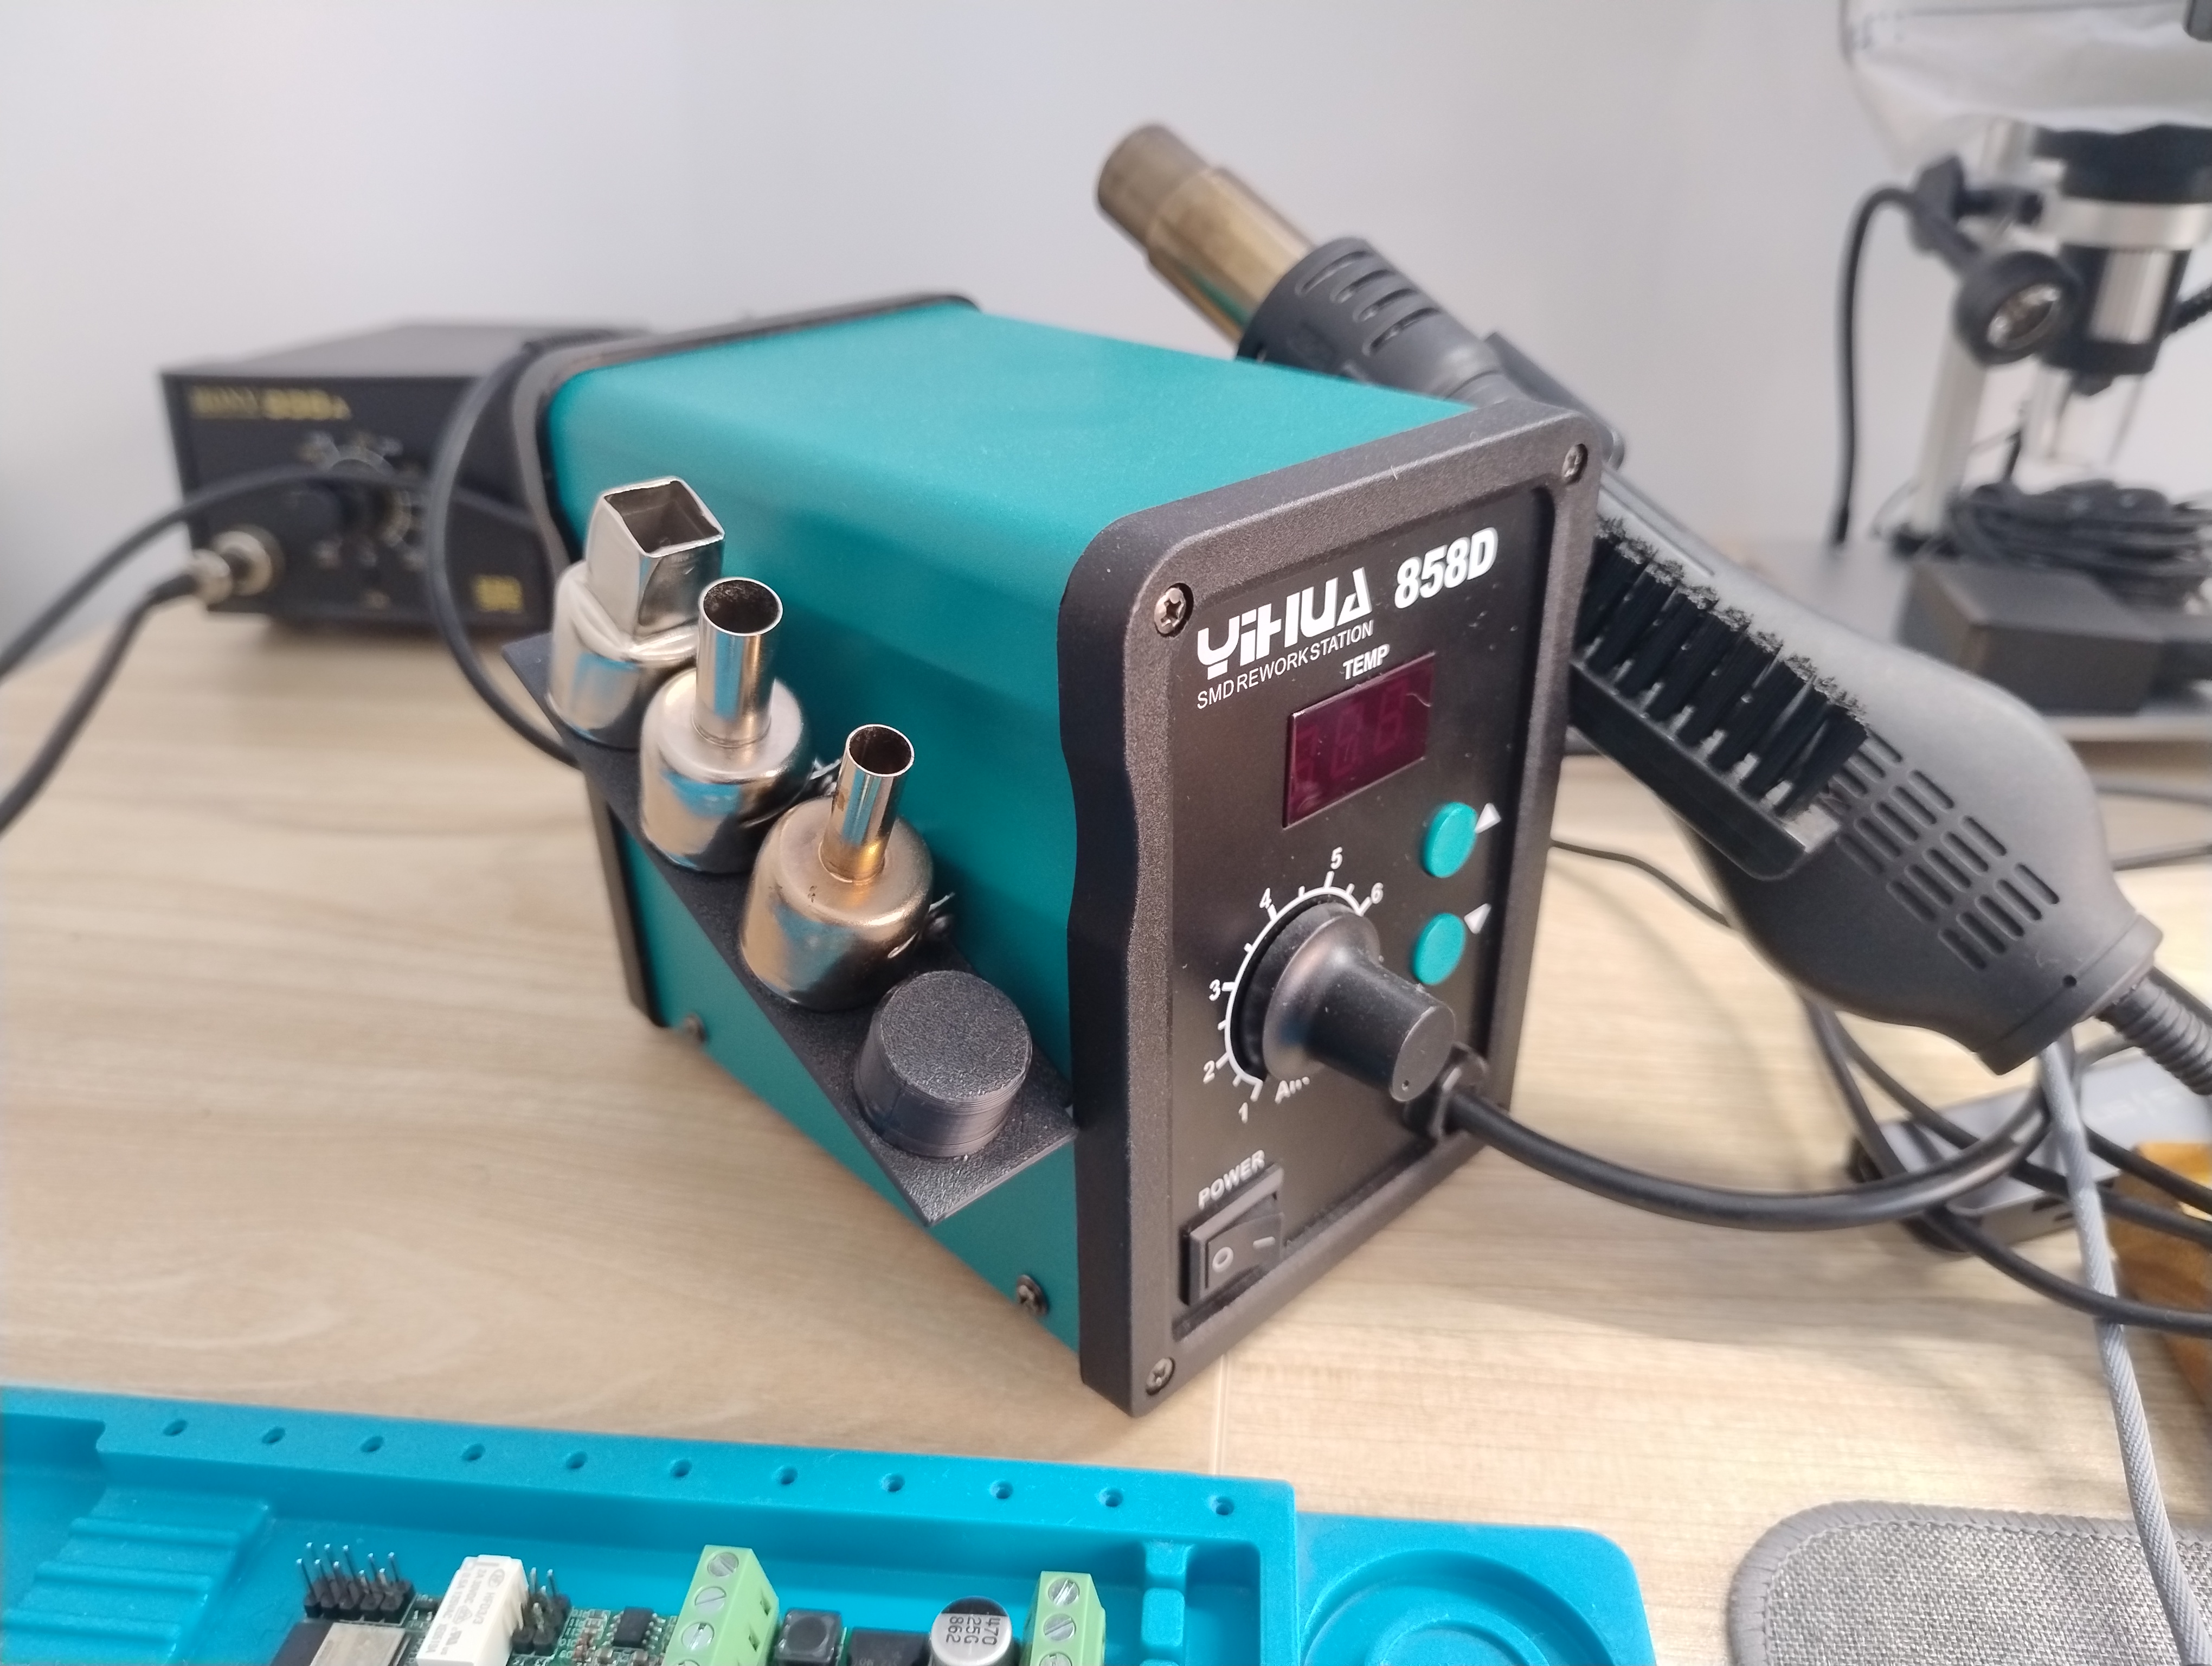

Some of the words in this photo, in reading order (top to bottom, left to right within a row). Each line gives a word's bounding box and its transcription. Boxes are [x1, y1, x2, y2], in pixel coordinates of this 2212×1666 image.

[1394, 527, 1498, 609] 858D
[1197, 680, 1234, 709] SMD
[1237, 647, 1308, 693] REWORK
[1310, 619, 1374, 661] STATION
[1343, 643, 1390, 680] TEMP
[1330, 847, 1343, 869] 5
[1259, 888, 1271, 909] 4
[1370, 882, 1384, 902] 6
[1208, 979, 1221, 1001] 3
[1203, 1060, 1216, 1084] 2
[1238, 1103, 1248, 1123] 1
[1198, 1149, 1265, 1210] POWER
[946, 1616, 964, 1643] 862
[964, 1616, 982, 1644] 25G
[982, 1617, 1001, 1645] 470
